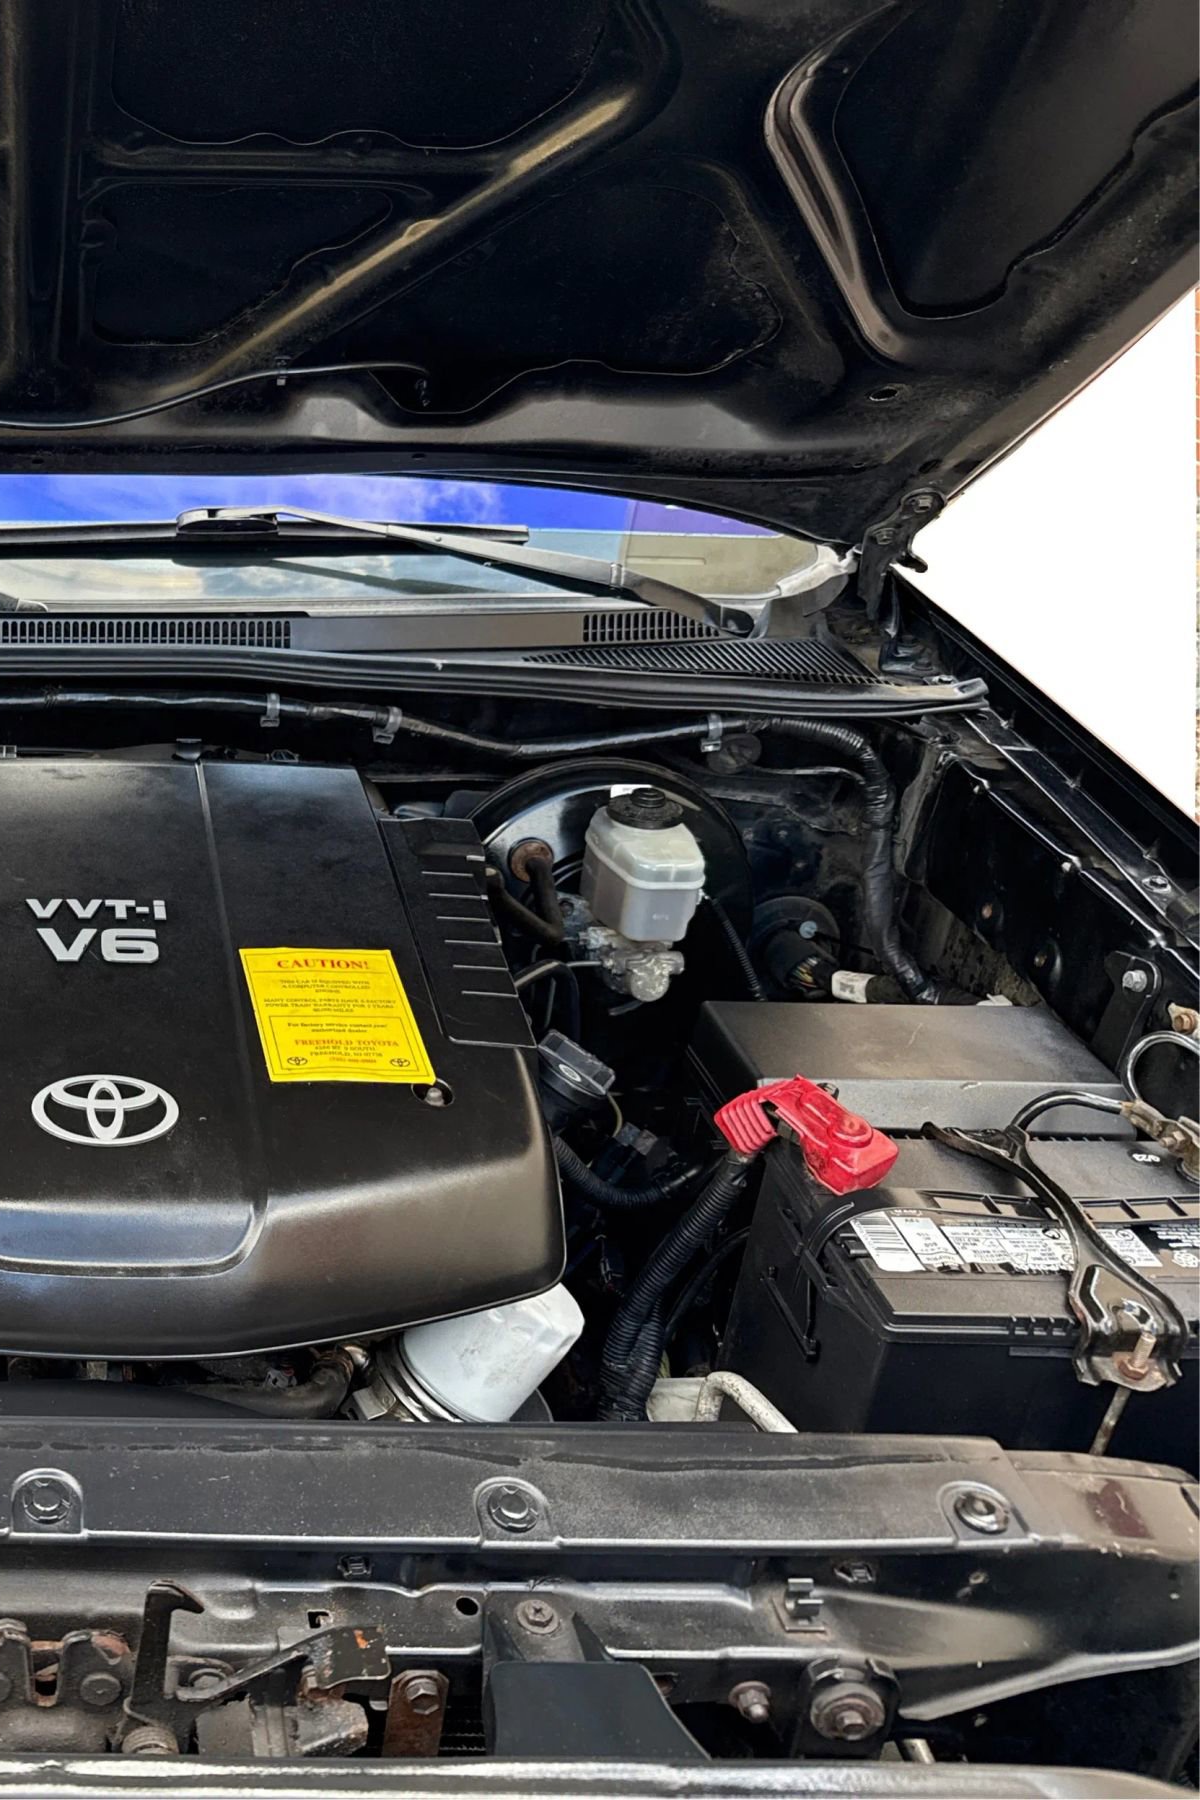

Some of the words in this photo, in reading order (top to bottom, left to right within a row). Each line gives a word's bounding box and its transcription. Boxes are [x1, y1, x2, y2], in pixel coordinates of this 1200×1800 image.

[26, 899, 167, 920] VVT-i
[36, 928, 159, 963] V6
[277, 960, 369, 969] CAUTION!
